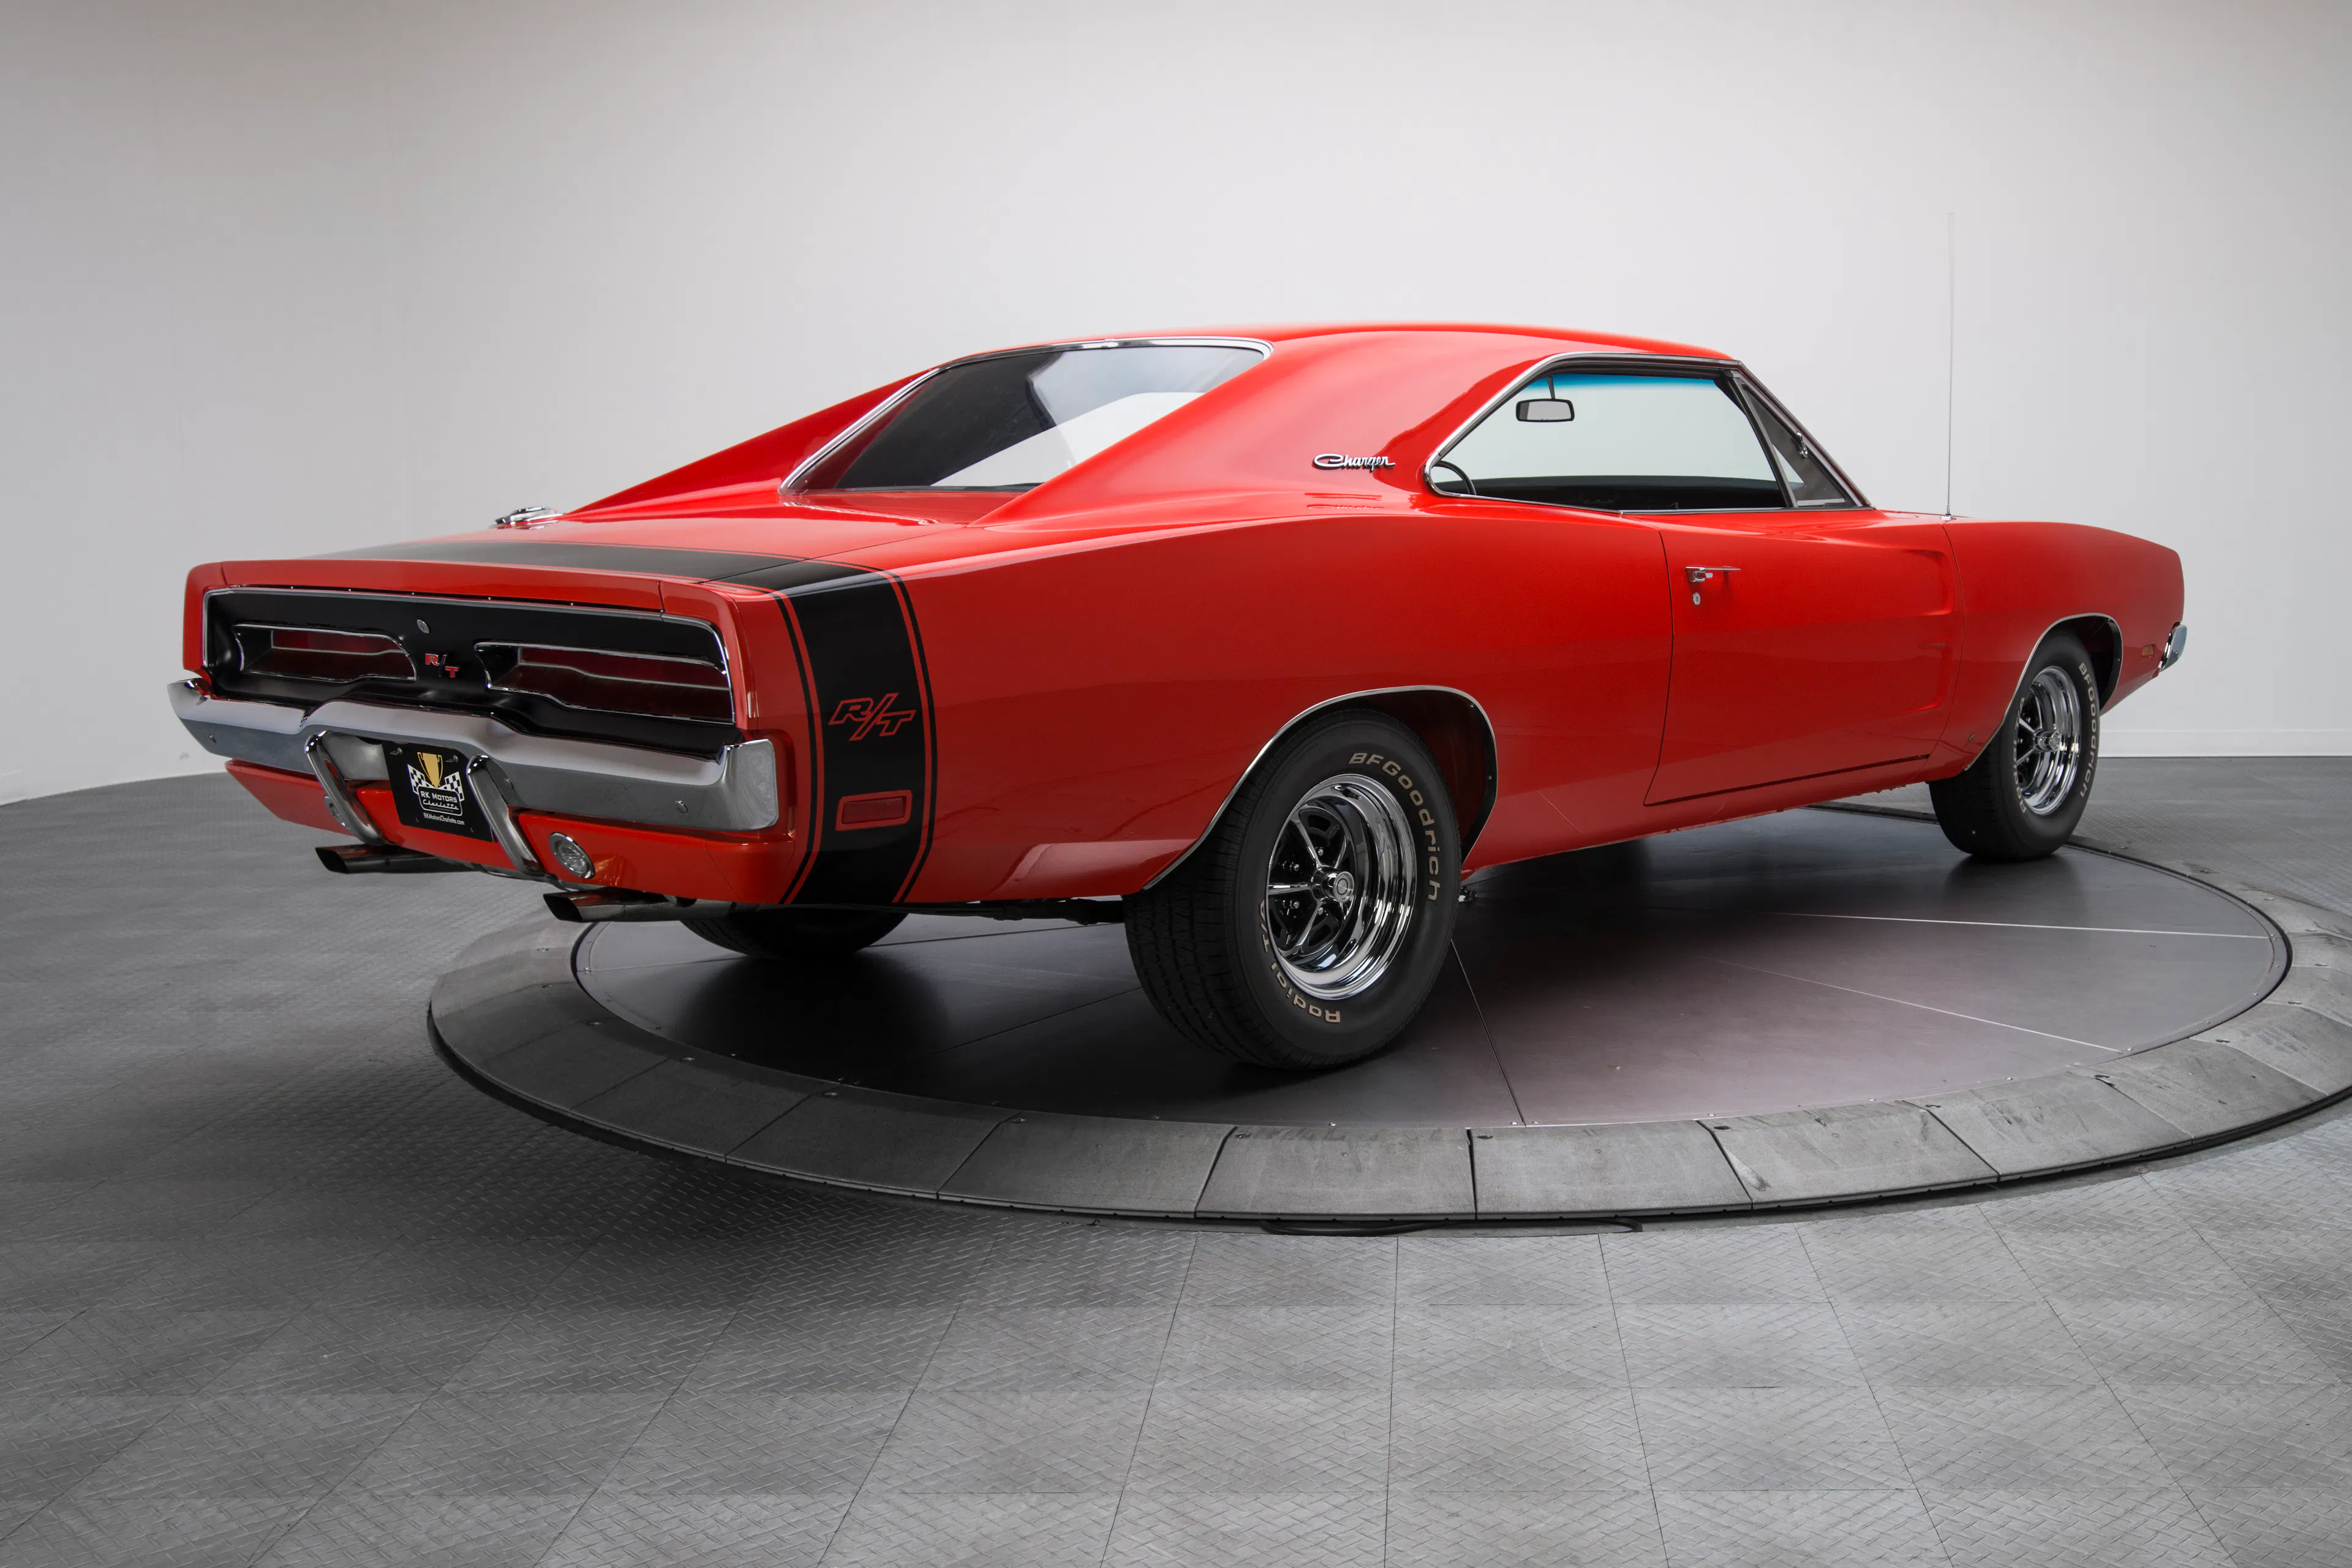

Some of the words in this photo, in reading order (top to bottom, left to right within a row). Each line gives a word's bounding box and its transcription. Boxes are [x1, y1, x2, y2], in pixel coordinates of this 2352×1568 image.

[1313, 453, 1396, 472] Charger
[424, 652, 459, 678] R/T
[828, 693, 917, 742] R/T
[2078, 662, 2098, 797] BFGoodrich
[423, 799, 459, 810] Charlotte
[432, 793, 458, 803] MOTORS
[423, 812, 465, 826] RKMotorsCharlotte.com
[1348, 752, 1441, 901] BFGoodrich
[1271, 960, 1341, 1023] Radial
